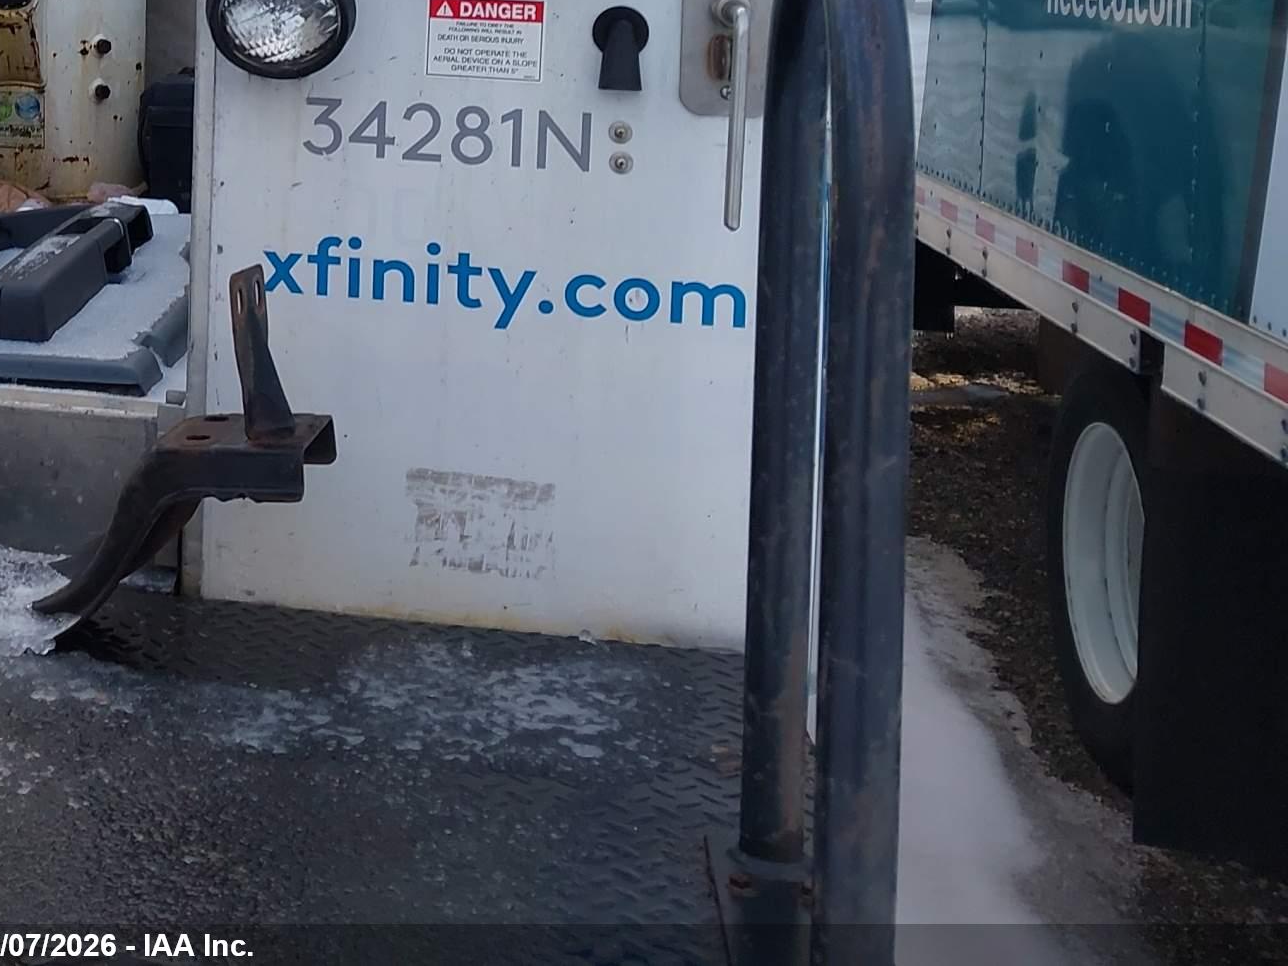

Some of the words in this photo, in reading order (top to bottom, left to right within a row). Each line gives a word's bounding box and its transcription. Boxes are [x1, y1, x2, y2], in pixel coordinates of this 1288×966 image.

[459, 1, 537, 21] DANGER
[437, 33, 459, 41] DEATH
[459, 34, 470, 42] OR
[471, 35, 500, 43] SERIOUS
[501, 36, 524, 45] INJURY
[474, 49, 510, 57] OPERATE
[513, 50, 527, 58] THE
[433, 55, 459, 63] AERIAL
[461, 56, 490, 65] DEVICE
[491, 58, 503, 66] ON
[512, 59, 538, 67] SLOPE
[450, 64, 487, 73] GREATER
[489, 66, 510, 74] THAN
[302, 96, 592, 172] 34281N
[263, 236, 747, 330] xfinity.com
